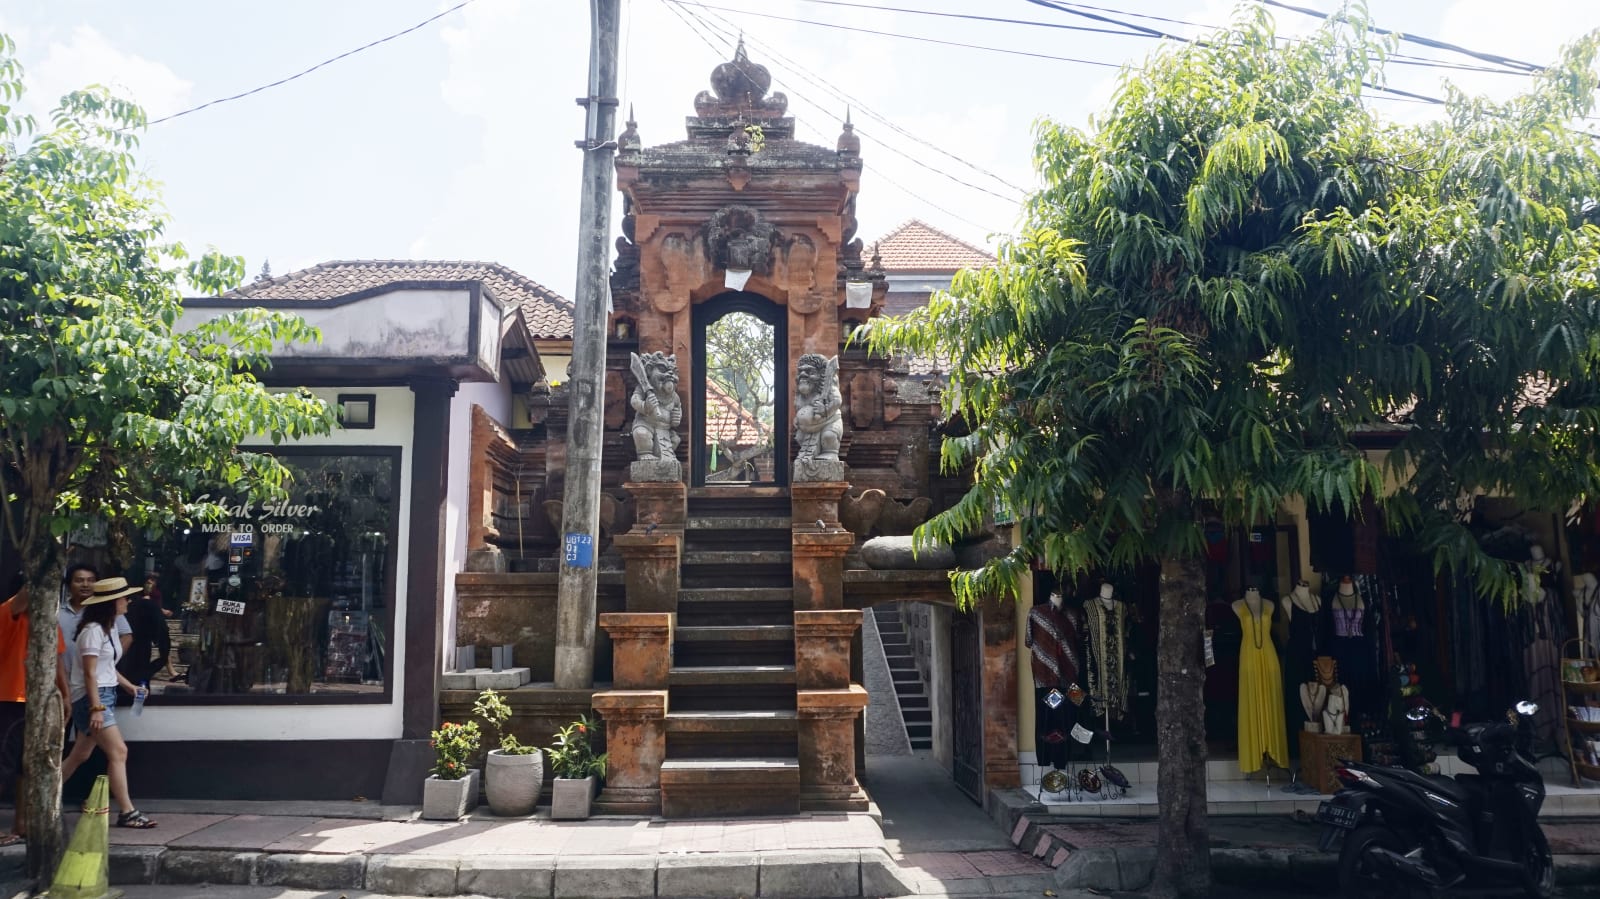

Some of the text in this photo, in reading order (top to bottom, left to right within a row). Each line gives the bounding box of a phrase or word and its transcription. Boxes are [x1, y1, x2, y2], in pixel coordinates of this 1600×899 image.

[258, 496, 321, 520] Silver
[202, 524, 294, 533] MADE TO ORDER
[233, 534, 251, 542] VISA
[221, 606, 241, 614] OPEN
